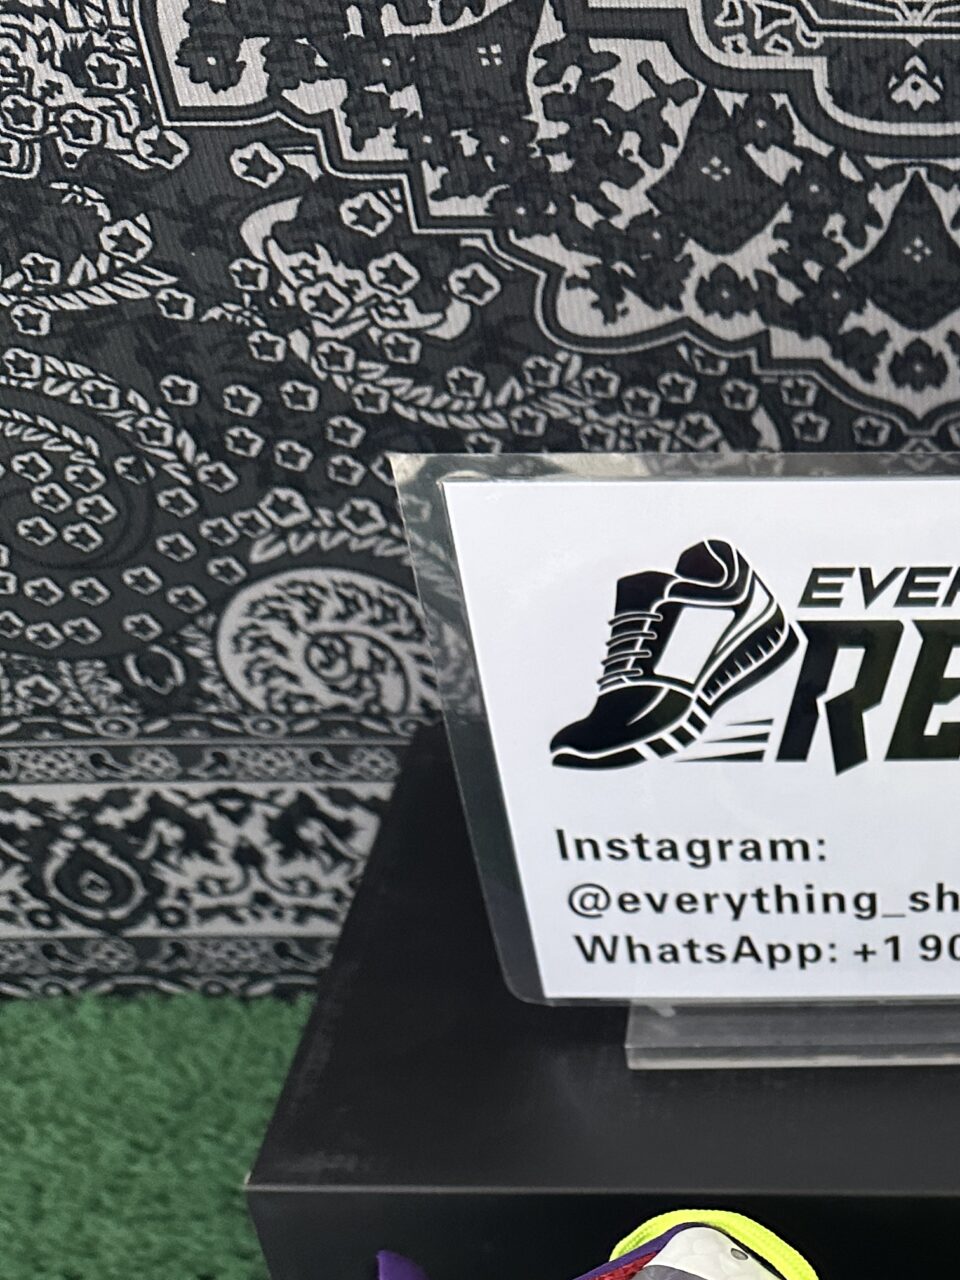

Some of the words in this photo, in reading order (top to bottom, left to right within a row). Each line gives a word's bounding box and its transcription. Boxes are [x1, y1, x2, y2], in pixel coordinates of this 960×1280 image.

[556, 829, 826, 869] Instagram:
[574, 934, 837, 970] WhatsApp:
[853, 934, 901, 963] +1
